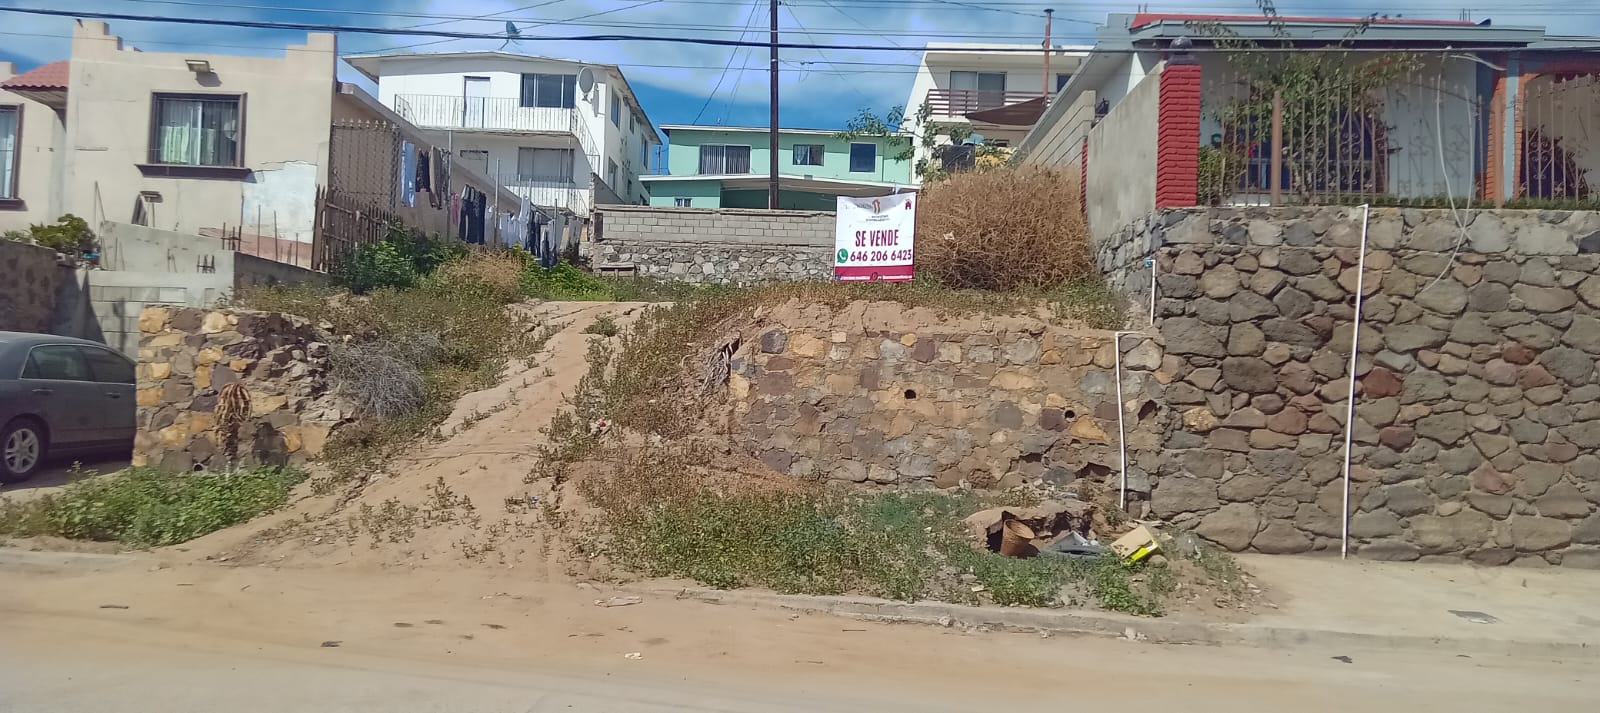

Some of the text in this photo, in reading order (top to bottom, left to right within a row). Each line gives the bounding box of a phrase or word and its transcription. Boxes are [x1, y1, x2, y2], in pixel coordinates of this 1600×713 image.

[855, 229, 899, 247] SE VENDE
[850, 249, 912, 262] 646 206 6423
